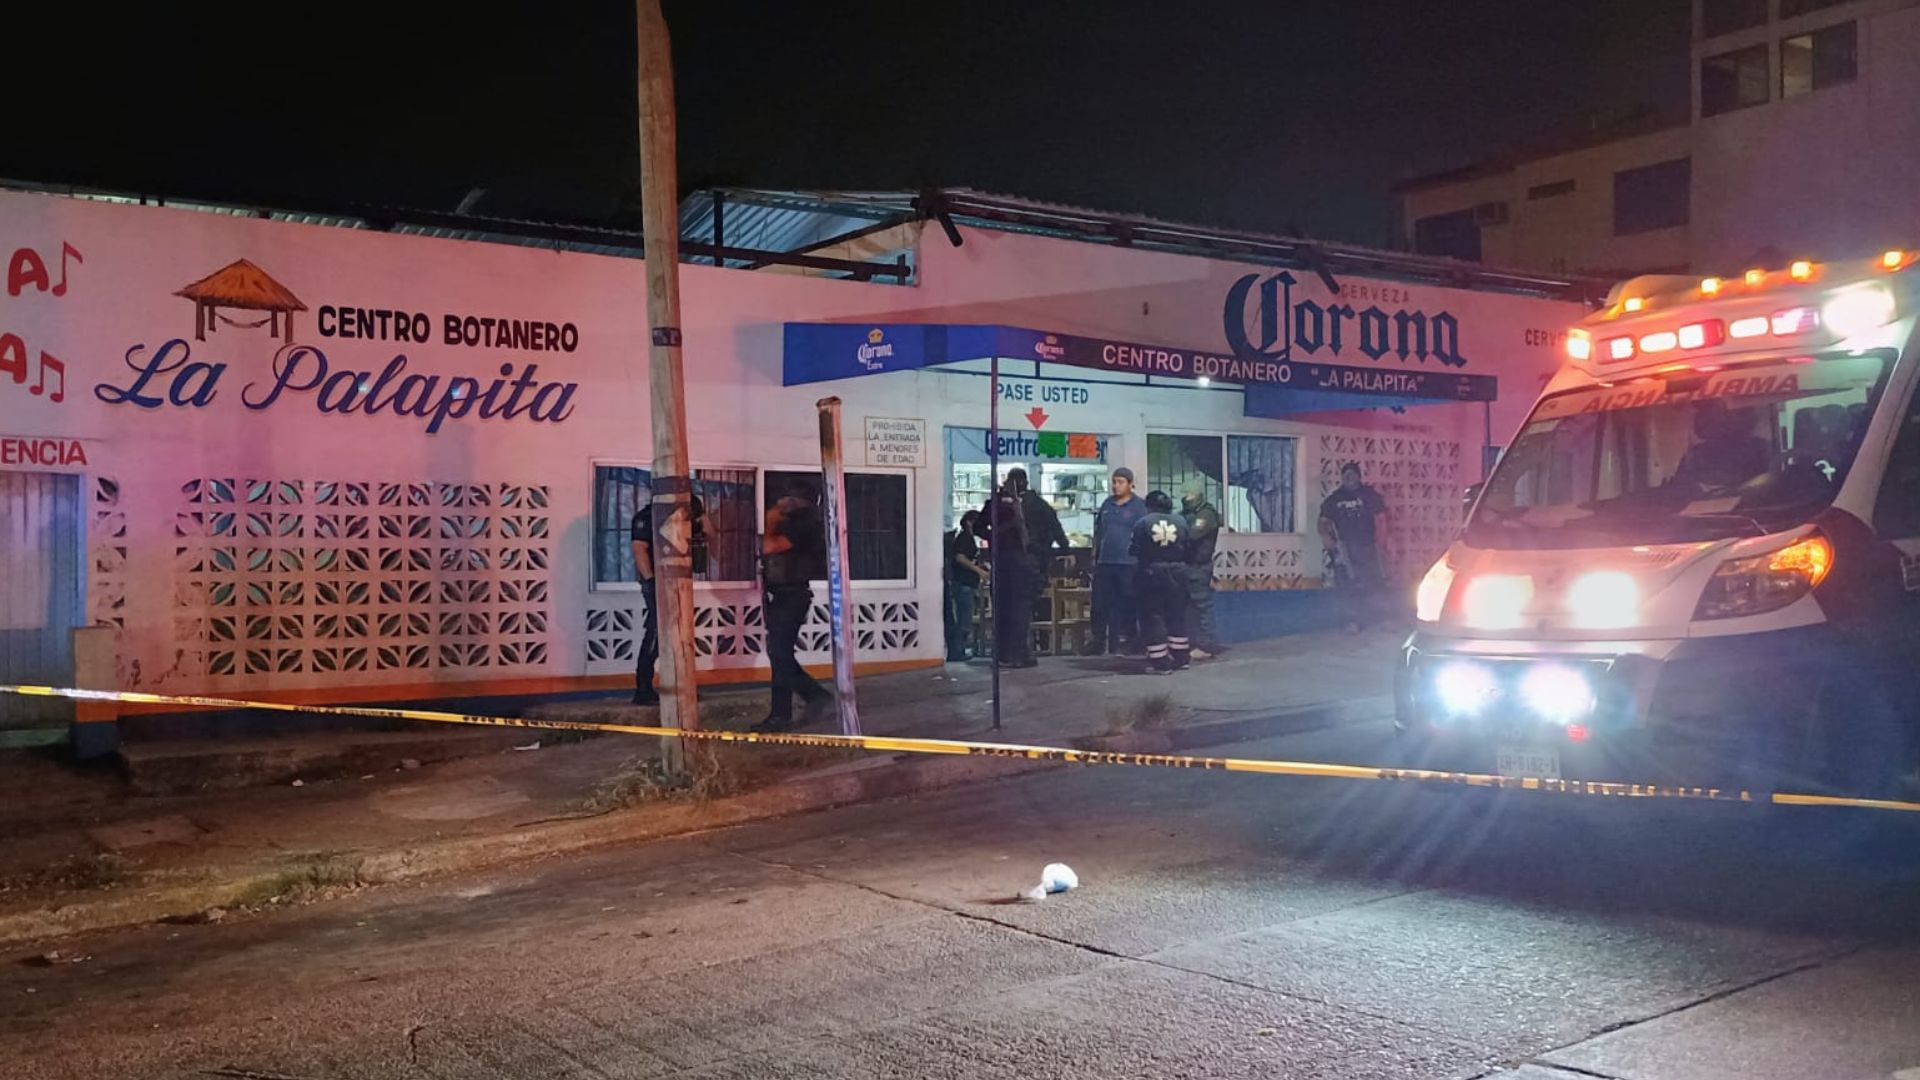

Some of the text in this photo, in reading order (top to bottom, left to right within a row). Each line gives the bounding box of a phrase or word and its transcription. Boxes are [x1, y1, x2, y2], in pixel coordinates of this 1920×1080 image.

[8, 248, 49, 296] A
[1341, 283, 1409, 304] CERVEZA
[318, 305, 579, 352] CENTRO BOTANERO
[1223, 270, 1467, 368] Corona
[1103, 344, 1183, 373] CENTRO
[1193, 356, 1292, 383] BOTANERO
[94, 338, 578, 434] La Palapita
[997, 383, 1089, 404] PASE USTED
[1, 439, 87, 466] ENCIA
[868, 432, 880, 441] LA
[870, 443, 876, 451] A
